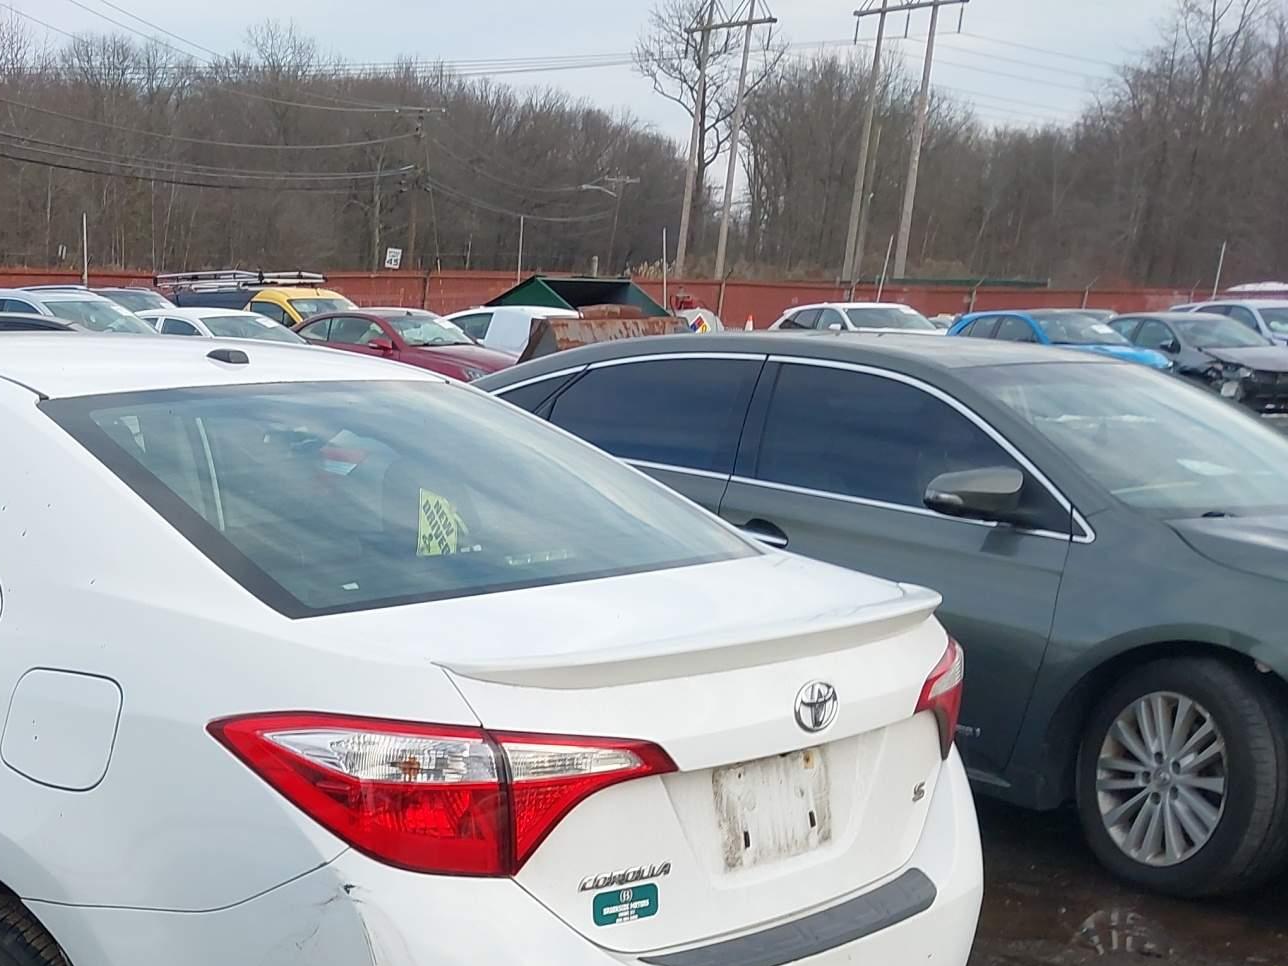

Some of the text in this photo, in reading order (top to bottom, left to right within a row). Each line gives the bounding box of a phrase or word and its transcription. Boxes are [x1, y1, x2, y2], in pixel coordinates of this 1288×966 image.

[433, 500, 454, 536] NEW
[912, 781, 925, 802] S
[577, 862, 671, 891] COROLLA
